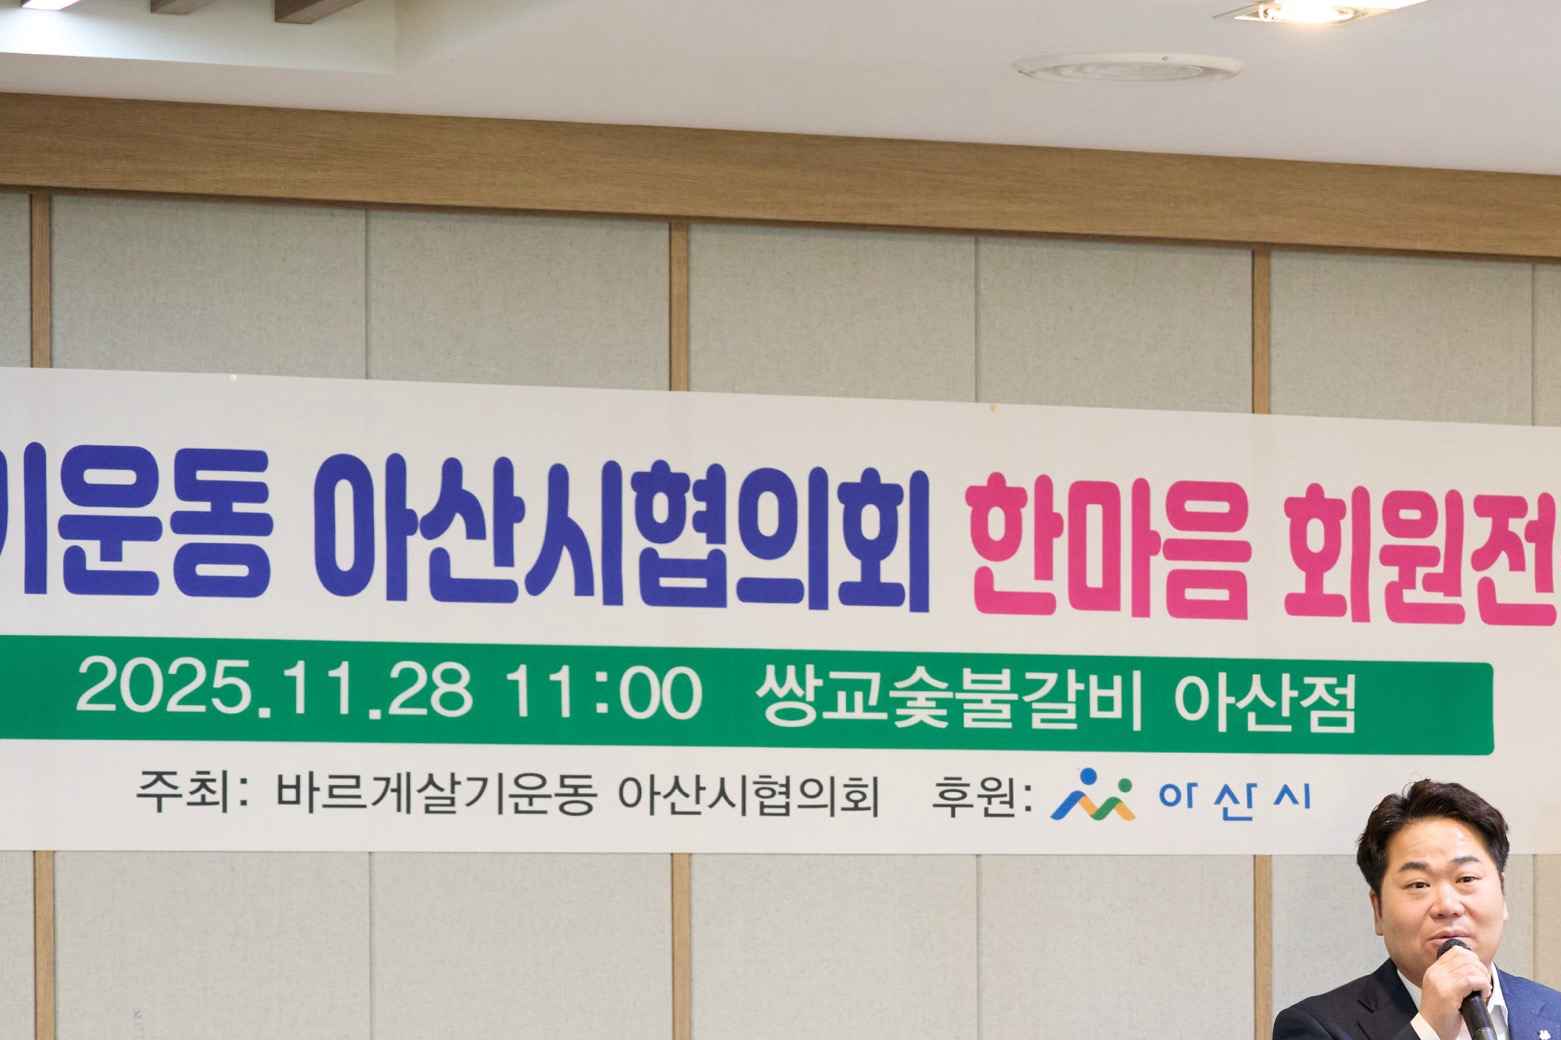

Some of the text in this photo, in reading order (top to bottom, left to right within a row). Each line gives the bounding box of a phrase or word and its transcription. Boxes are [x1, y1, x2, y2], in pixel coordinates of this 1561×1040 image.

[314, 453, 929, 612] 아산시협의회
[965, 472, 1252, 620] 한마음
[76, 655, 1358, 733] 2025.11.28 11:00 쌍교숯불갈비 아산점
[136, 769, 1032, 818] 주최: 바르게살기운동 아산시협의회 후원:
[1158, 782, 1312, 822] 아산시
